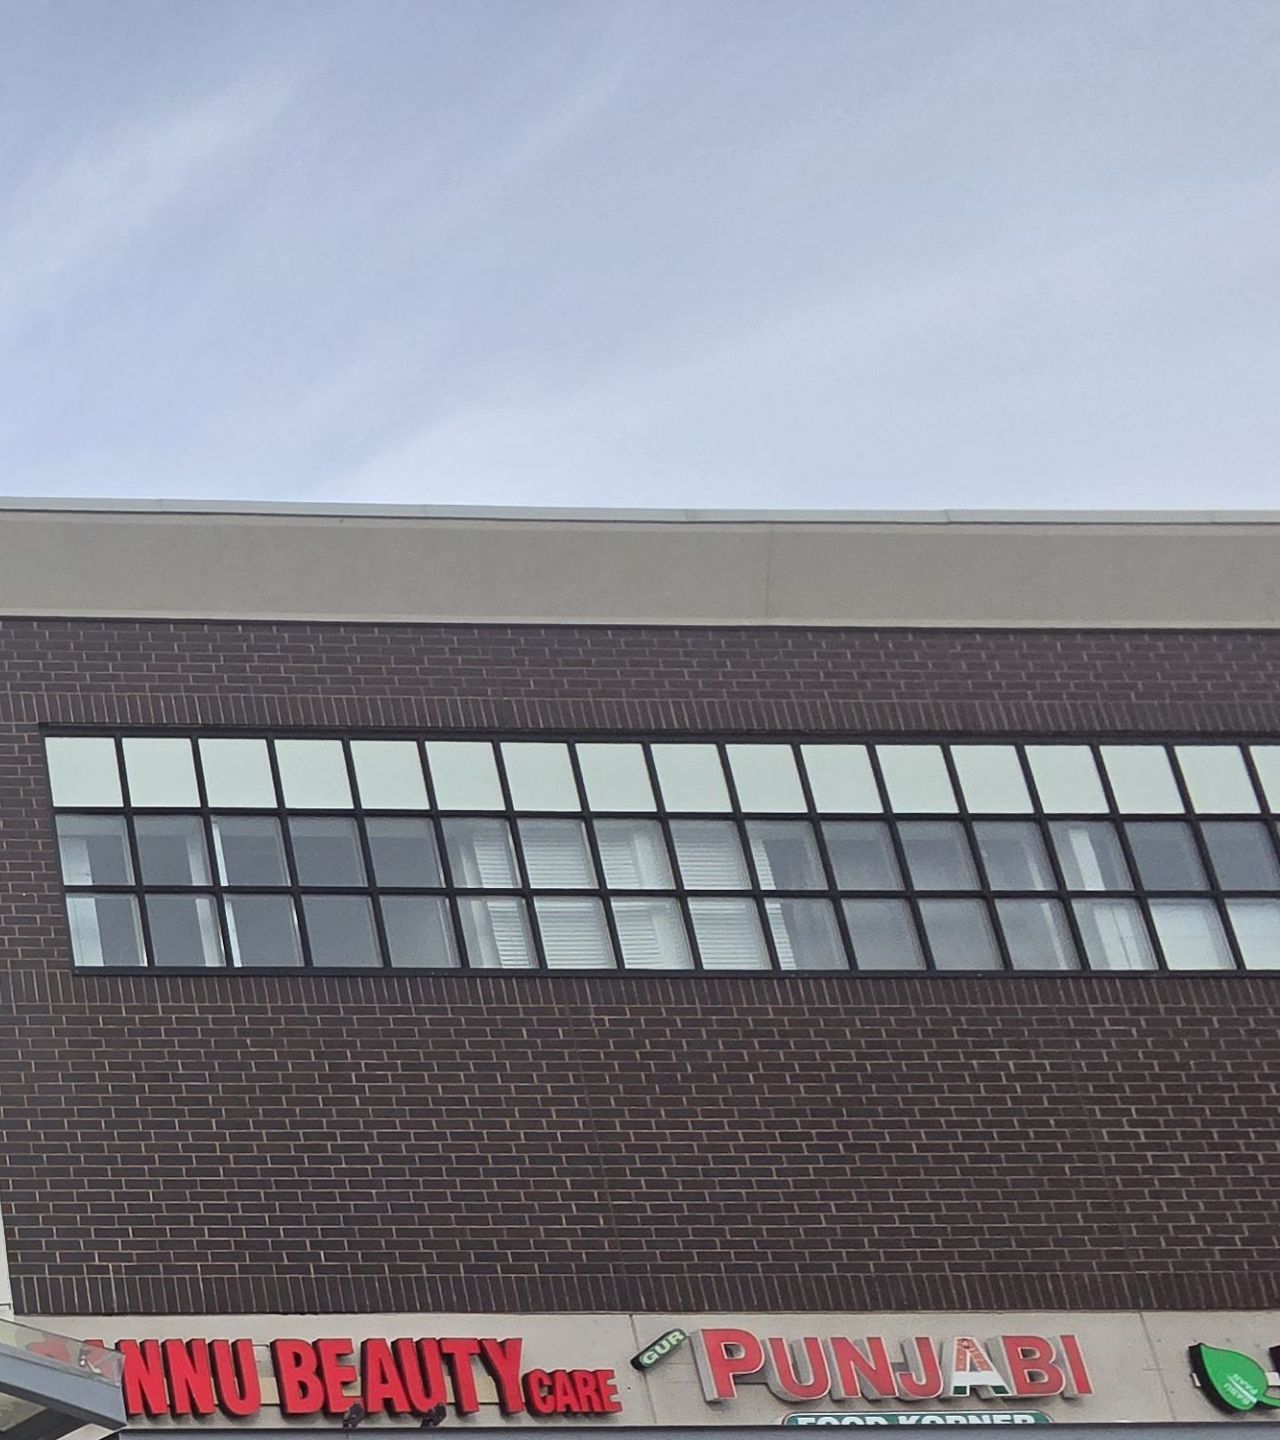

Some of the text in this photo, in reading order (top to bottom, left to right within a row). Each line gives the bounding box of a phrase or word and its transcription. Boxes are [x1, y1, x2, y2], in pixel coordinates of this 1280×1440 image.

[270, 1337, 623, 1414] BEAUTY CARE
[640, 1331, 685, 1366] GUR
[700, 1328, 1094, 1399] PUNJABI
